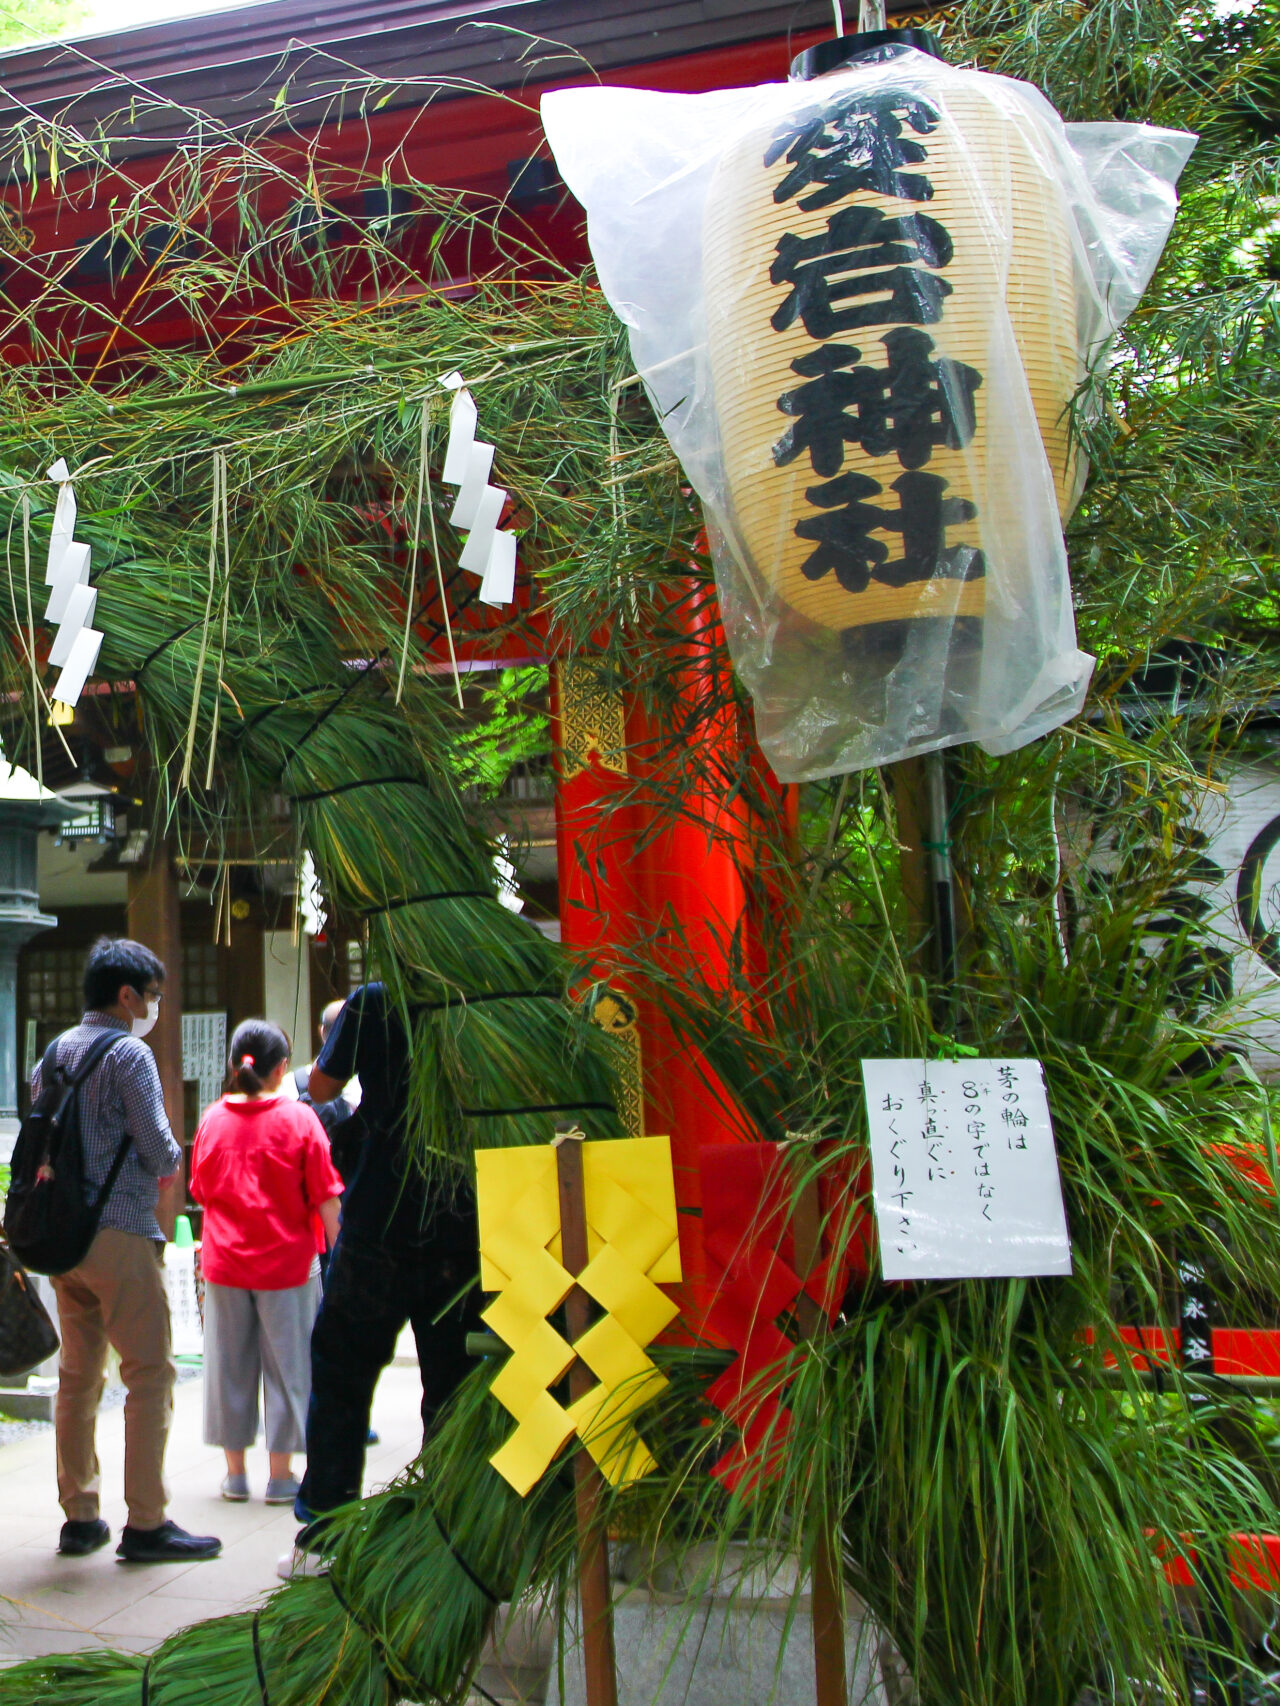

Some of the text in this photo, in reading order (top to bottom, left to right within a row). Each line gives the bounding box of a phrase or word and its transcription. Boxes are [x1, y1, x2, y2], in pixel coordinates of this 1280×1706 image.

[918, 1080, 947, 1182] 真っ直ぐに
[961, 1081, 995, 1222] 8の字ではなく
[997, 1066, 1030, 1150] 茅の輪は
[882, 1093, 918, 1254] おくぐり下さい
